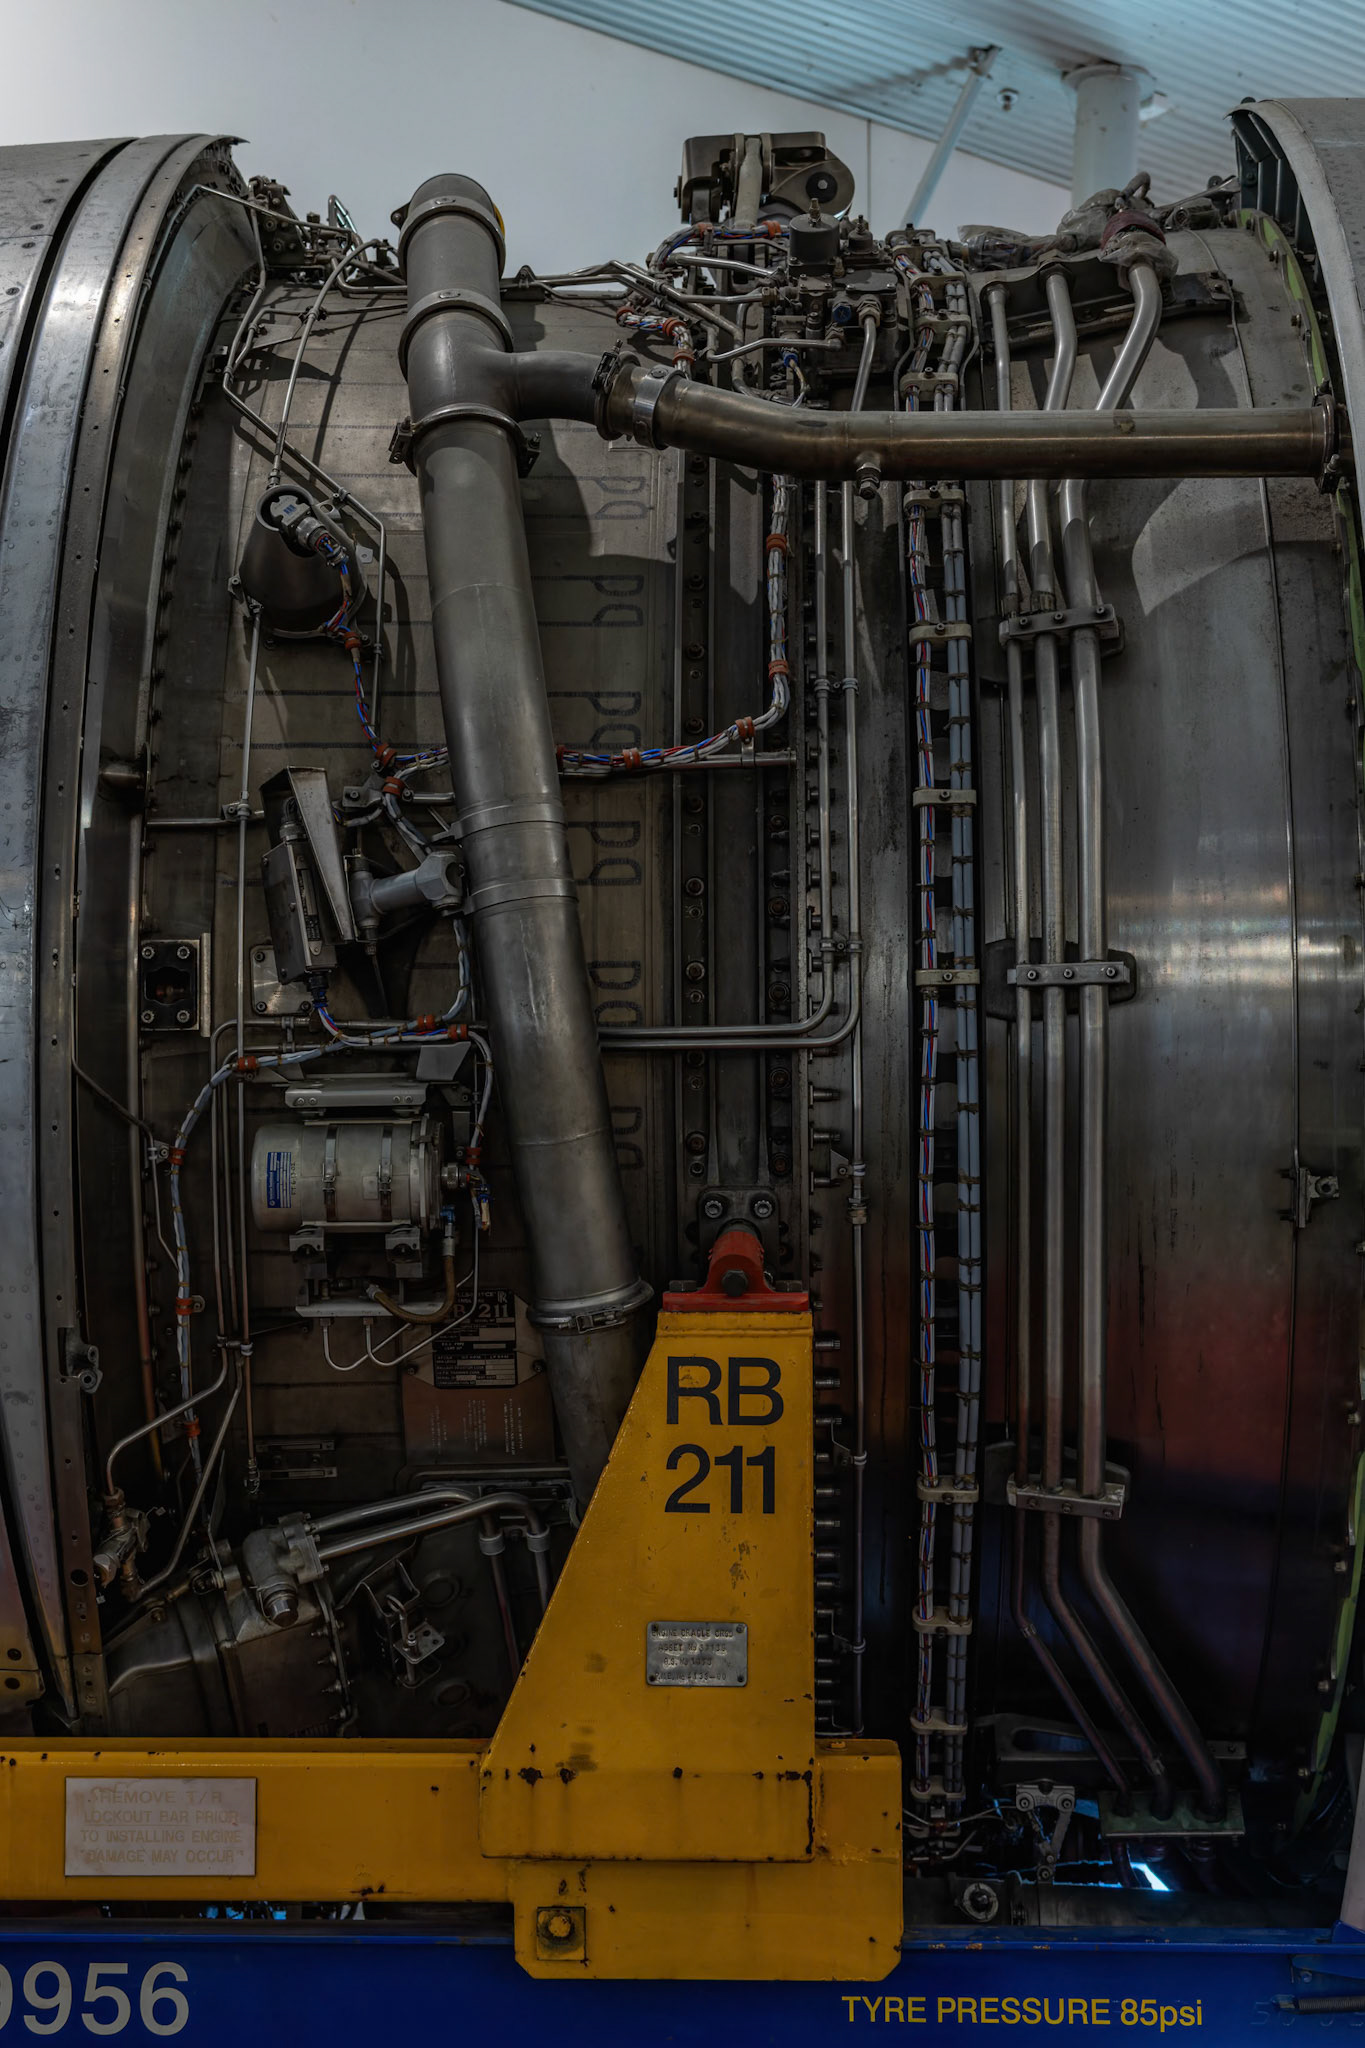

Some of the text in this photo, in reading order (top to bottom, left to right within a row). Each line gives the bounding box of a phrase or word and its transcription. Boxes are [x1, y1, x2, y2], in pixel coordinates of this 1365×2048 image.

[478, 1303, 509, 1318] 211
[667, 1356, 784, 1425] RB
[664, 1443, 776, 1514] 211
[658, 1643, 683, 1652] ASSET
[100, 1791, 222, 1804] REMOVE T/R
[84, 1810, 240, 1824] LOCKOUT BAR PRIOR
[80, 1829, 242, 1844] TO INSTALLING ENGINE
[151, 1849, 178, 1863] MAY
[0, 1960, 190, 2036] 956
[842, 1996, 1204, 2033] TYRE PRESSURE 85psi
